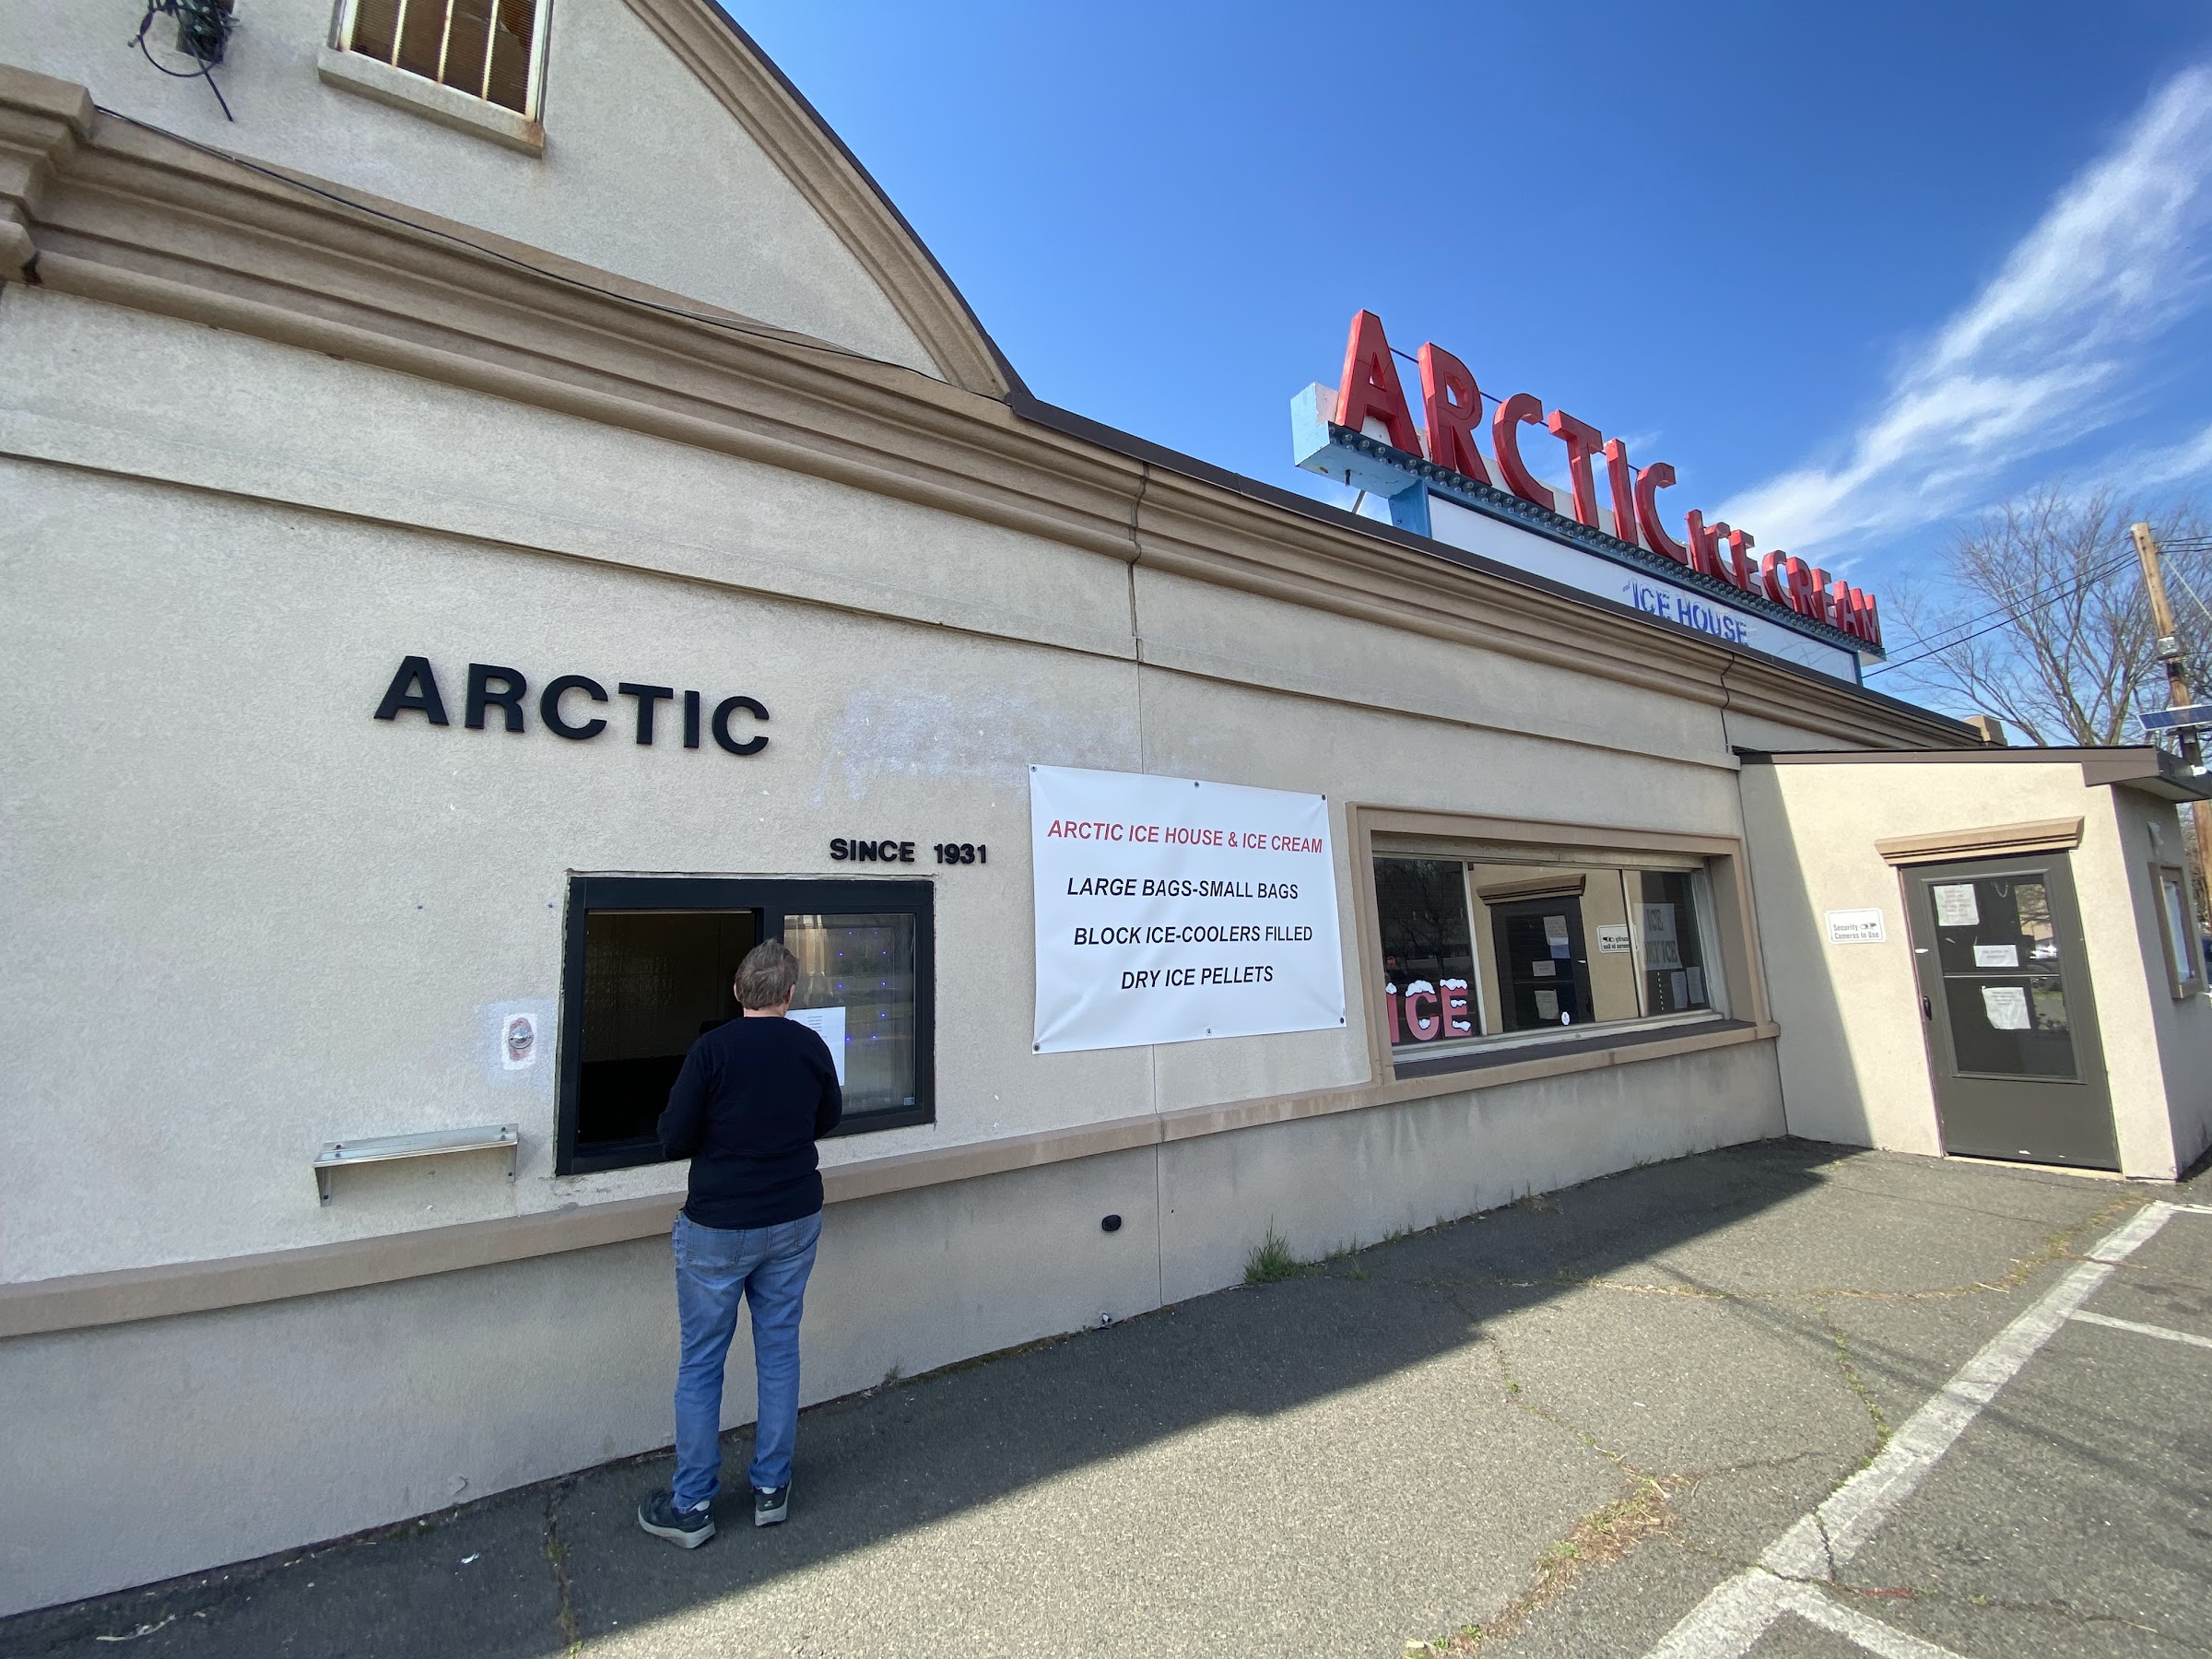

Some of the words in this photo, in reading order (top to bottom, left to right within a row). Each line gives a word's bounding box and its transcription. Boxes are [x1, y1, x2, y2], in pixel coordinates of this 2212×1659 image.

[1335, 309, 1688, 565] ARCTIC
[1684, 509, 1762, 596] ICE
[1761, 549, 1883, 648] CREAM
[1631, 579, 1673, 620] ICE
[1677, 595, 1749, 646] HOUSE
[373, 655, 770, 756] ARCTIC
[830, 838, 915, 863] SINCE
[933, 842, 987, 865] 1931
[1047, 819, 1124, 841] ARCTIC
[1128, 825, 1159, 842] ICE
[1164, 827, 1223, 847] HOUSE
[1228, 831, 1238, 848] &
[1242, 833, 1266, 850] ICE
[1271, 835, 1323, 853] CREAM
[1066, 877, 1137, 897] LARGE
[1142, 879, 1253, 899] BAGS-SMALL
[1257, 883, 1298, 900] BAGS
[1074, 926, 1142, 946] BLOCK
[1146, 925, 1260, 944] ICE-COOLERS
[1265, 925, 1312, 941] FILLED
[1121, 970, 1160, 989] DRY
[1165, 969, 1195, 986] ICE
[1200, 966, 1273, 984] PELLETS
[1385, 978, 1472, 1043] ICE
